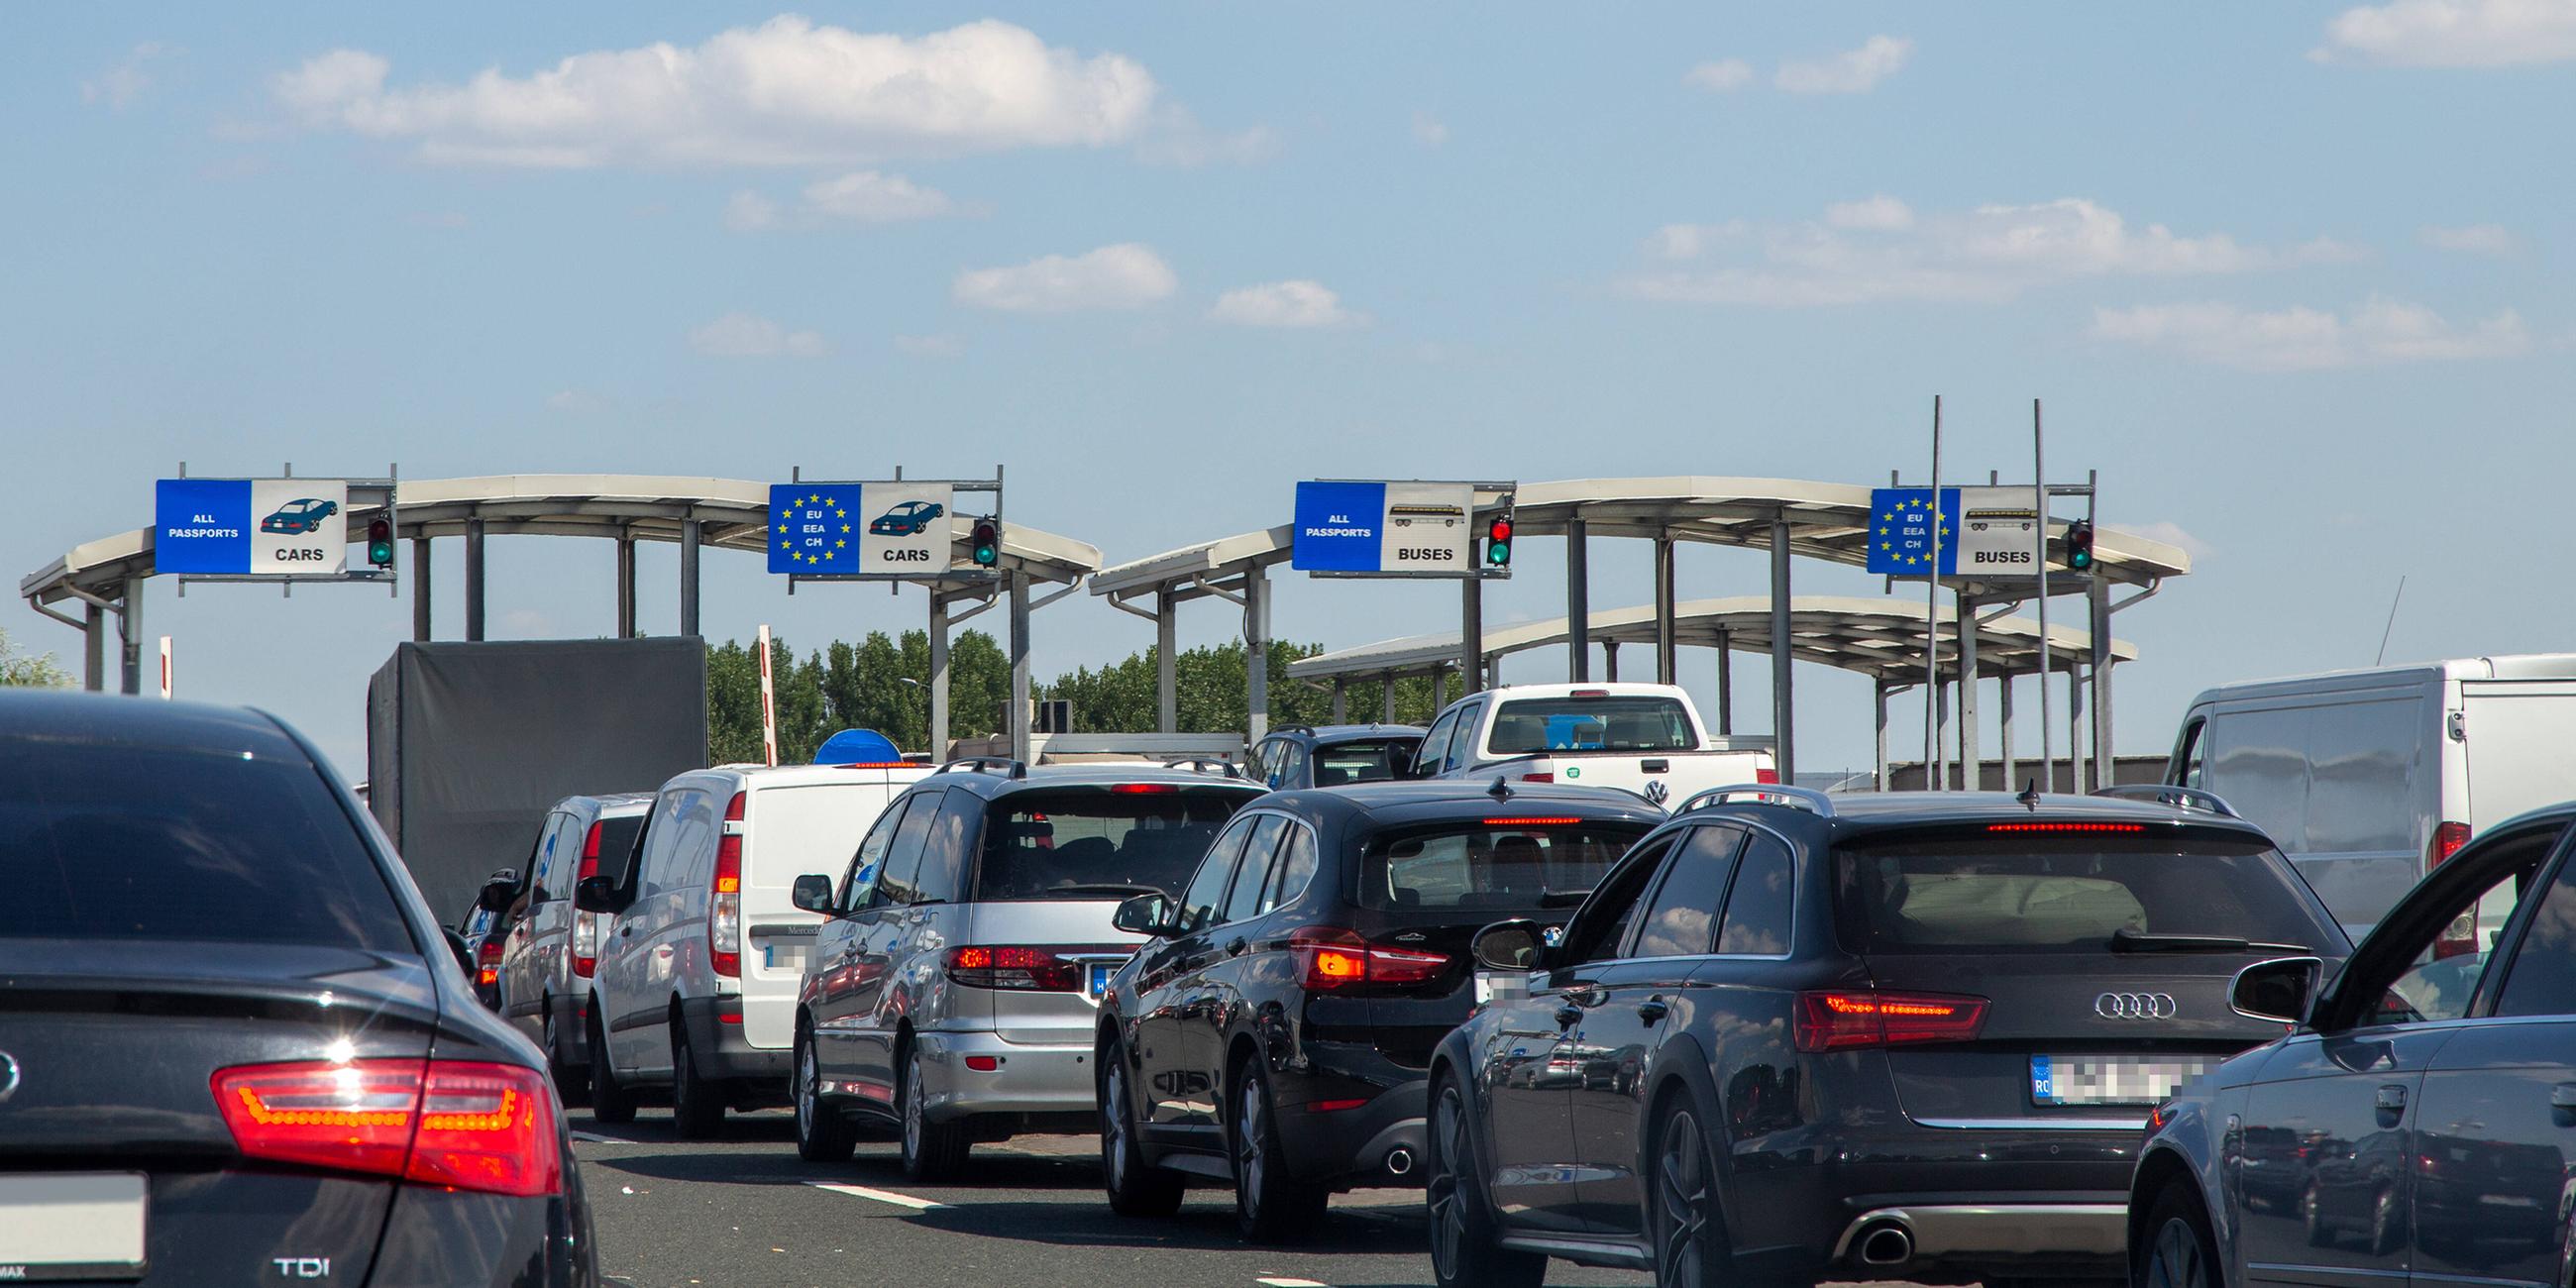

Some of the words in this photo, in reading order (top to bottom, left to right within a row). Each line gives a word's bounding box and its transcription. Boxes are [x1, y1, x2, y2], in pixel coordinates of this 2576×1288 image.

[192, 514, 216, 524] ALL
[805, 509, 822, 519] EU
[1328, 514, 1350, 524] ALL
[1906, 513, 1923, 523] EU
[168, 528, 239, 538] PASSPORTS
[803, 524, 825, 534] EEA
[1306, 527, 1371, 538] PASSPORTS
[1902, 526, 1926, 536] EEA
[805, 537, 823, 547] CH
[1904, 540, 1922, 549] CH
[274, 548, 324, 562] CARS
[883, 549, 930, 562] CARS
[1398, 548, 1453, 561] BUSES
[1975, 551, 2031, 564] BUSES
[1097, 982, 1105, 991] H
[274, 1257, 330, 1276] TDI
